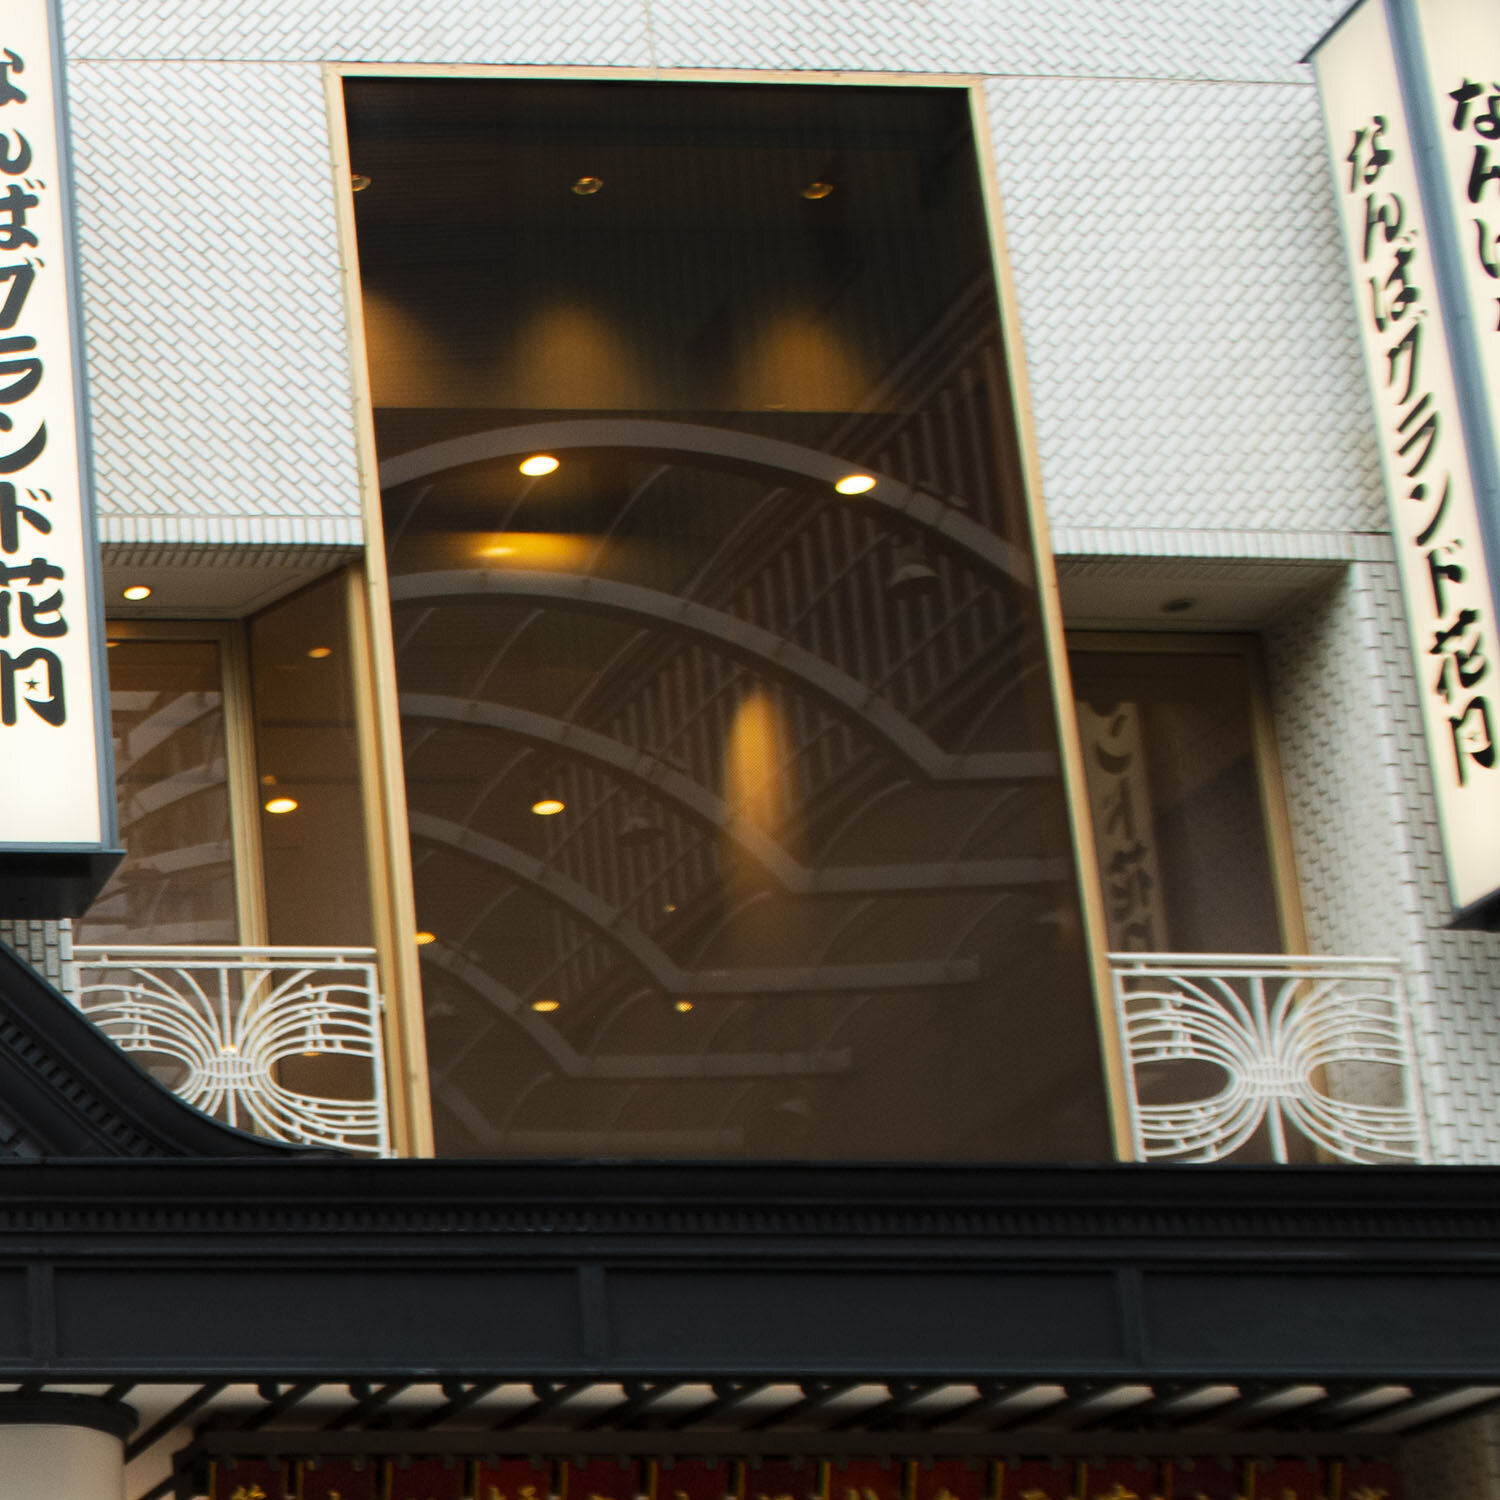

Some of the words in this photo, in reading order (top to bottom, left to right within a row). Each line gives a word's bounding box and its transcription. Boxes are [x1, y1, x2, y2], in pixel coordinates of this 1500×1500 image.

[1345, 114, 1499, 789] なんばグランド花月
